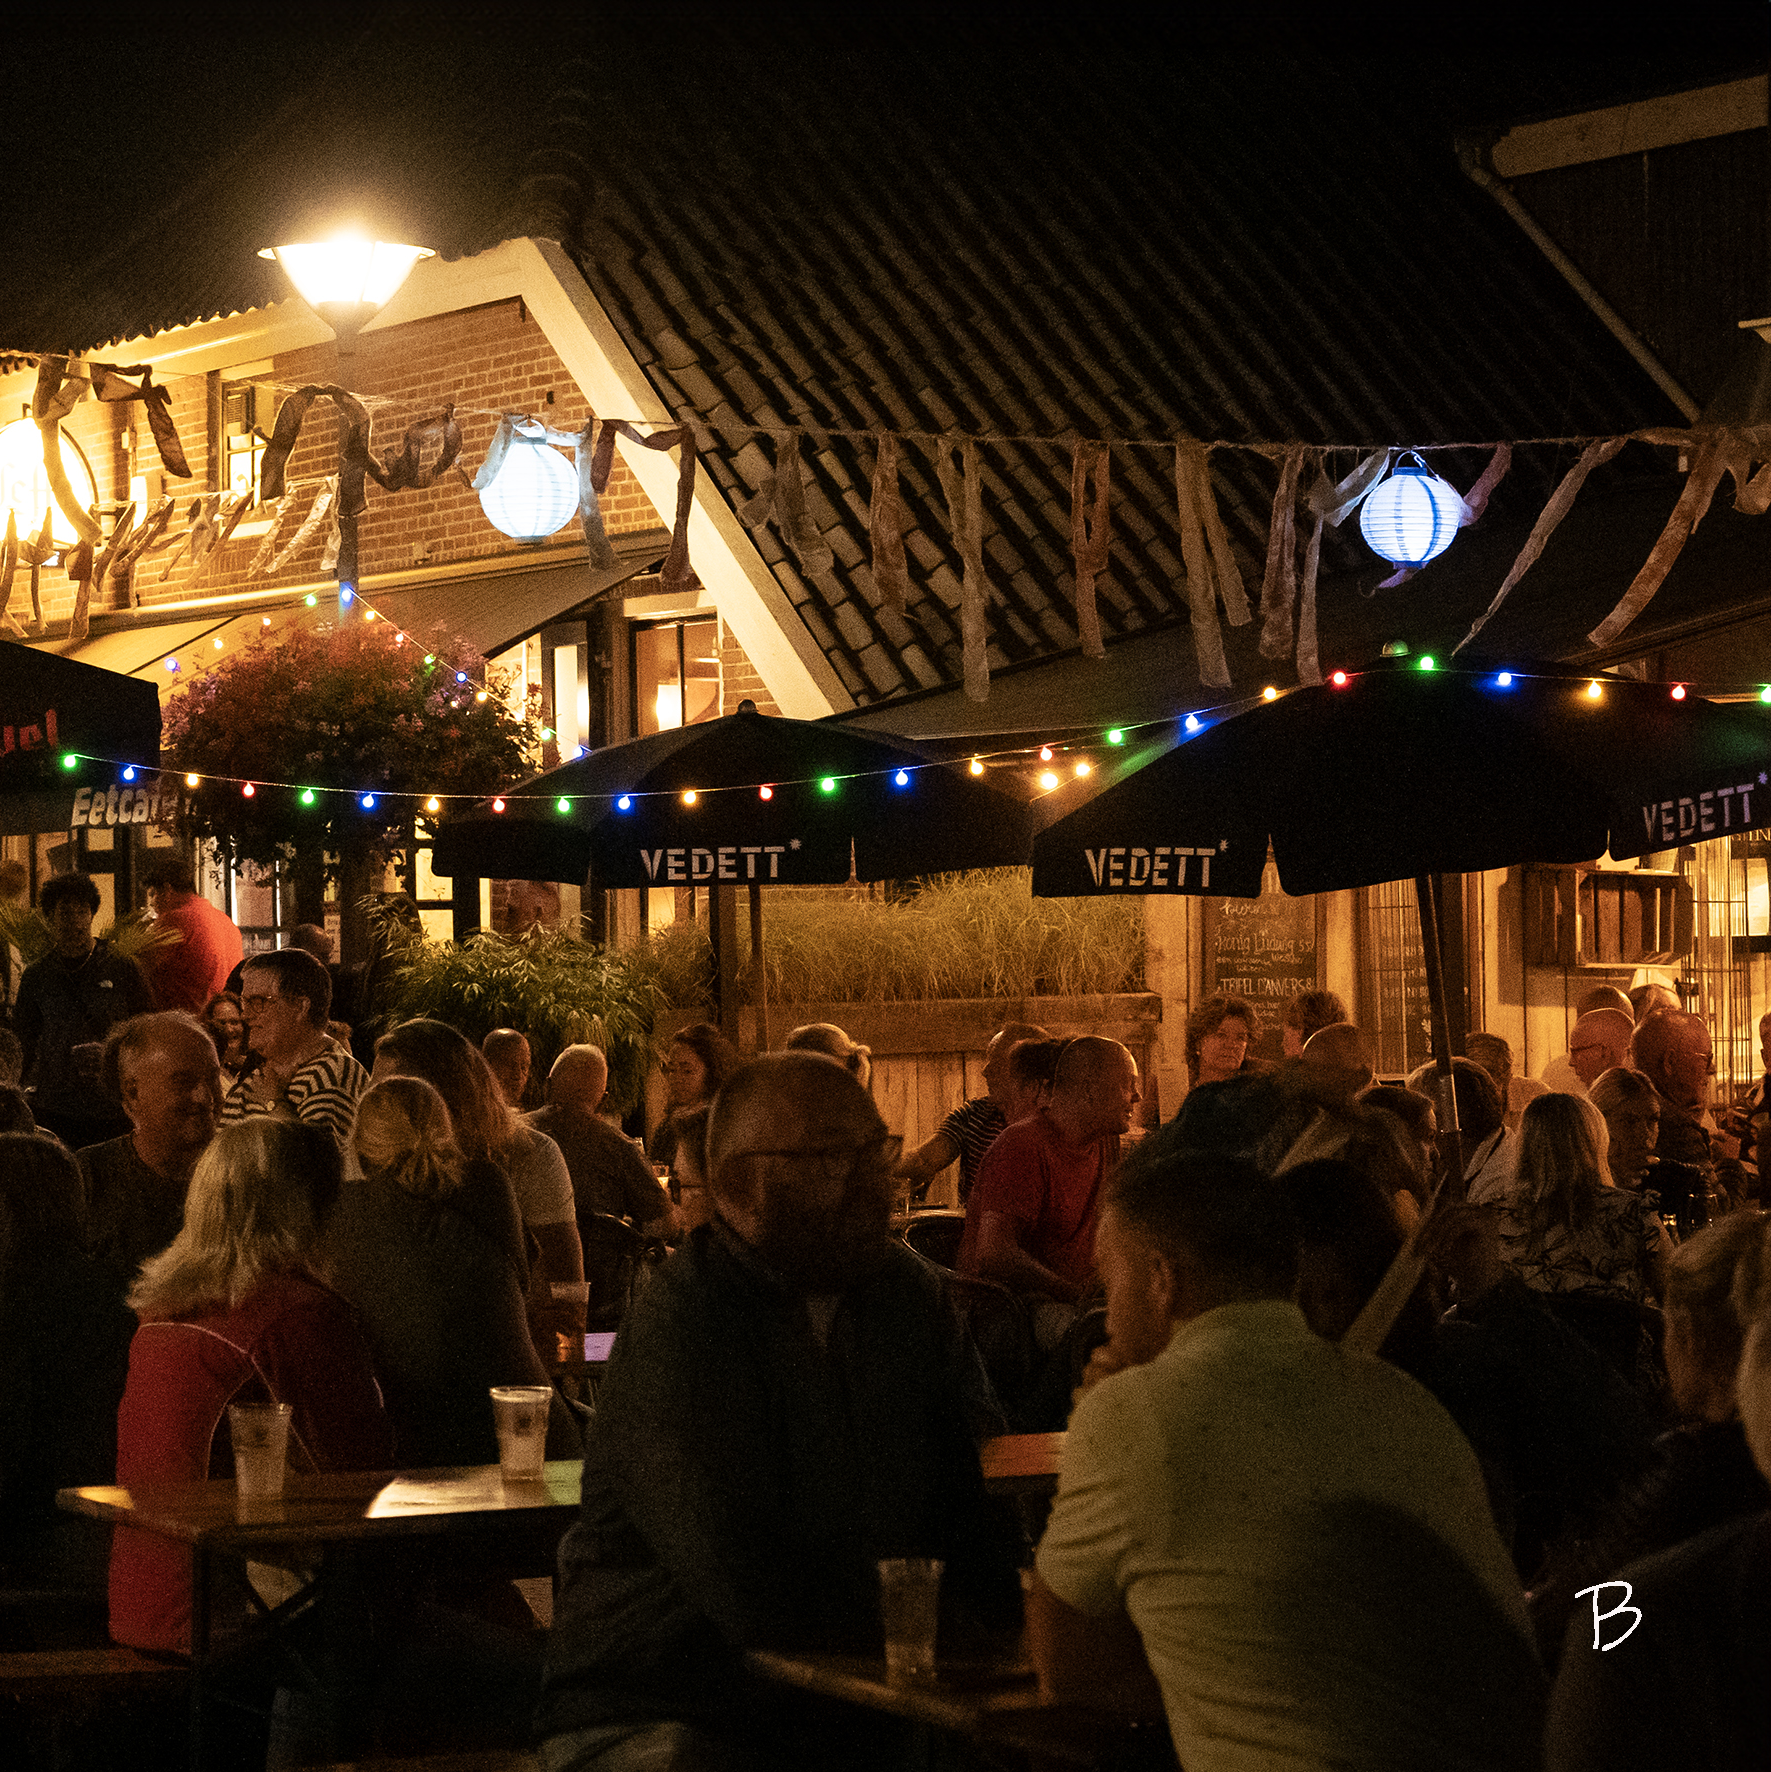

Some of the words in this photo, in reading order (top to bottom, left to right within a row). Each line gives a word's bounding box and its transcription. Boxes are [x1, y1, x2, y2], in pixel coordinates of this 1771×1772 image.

[1642, 783, 1755, 841] VEDETT
[639, 846, 786, 880] VEDETT
[1084, 846, 1217, 888] VEDETT
